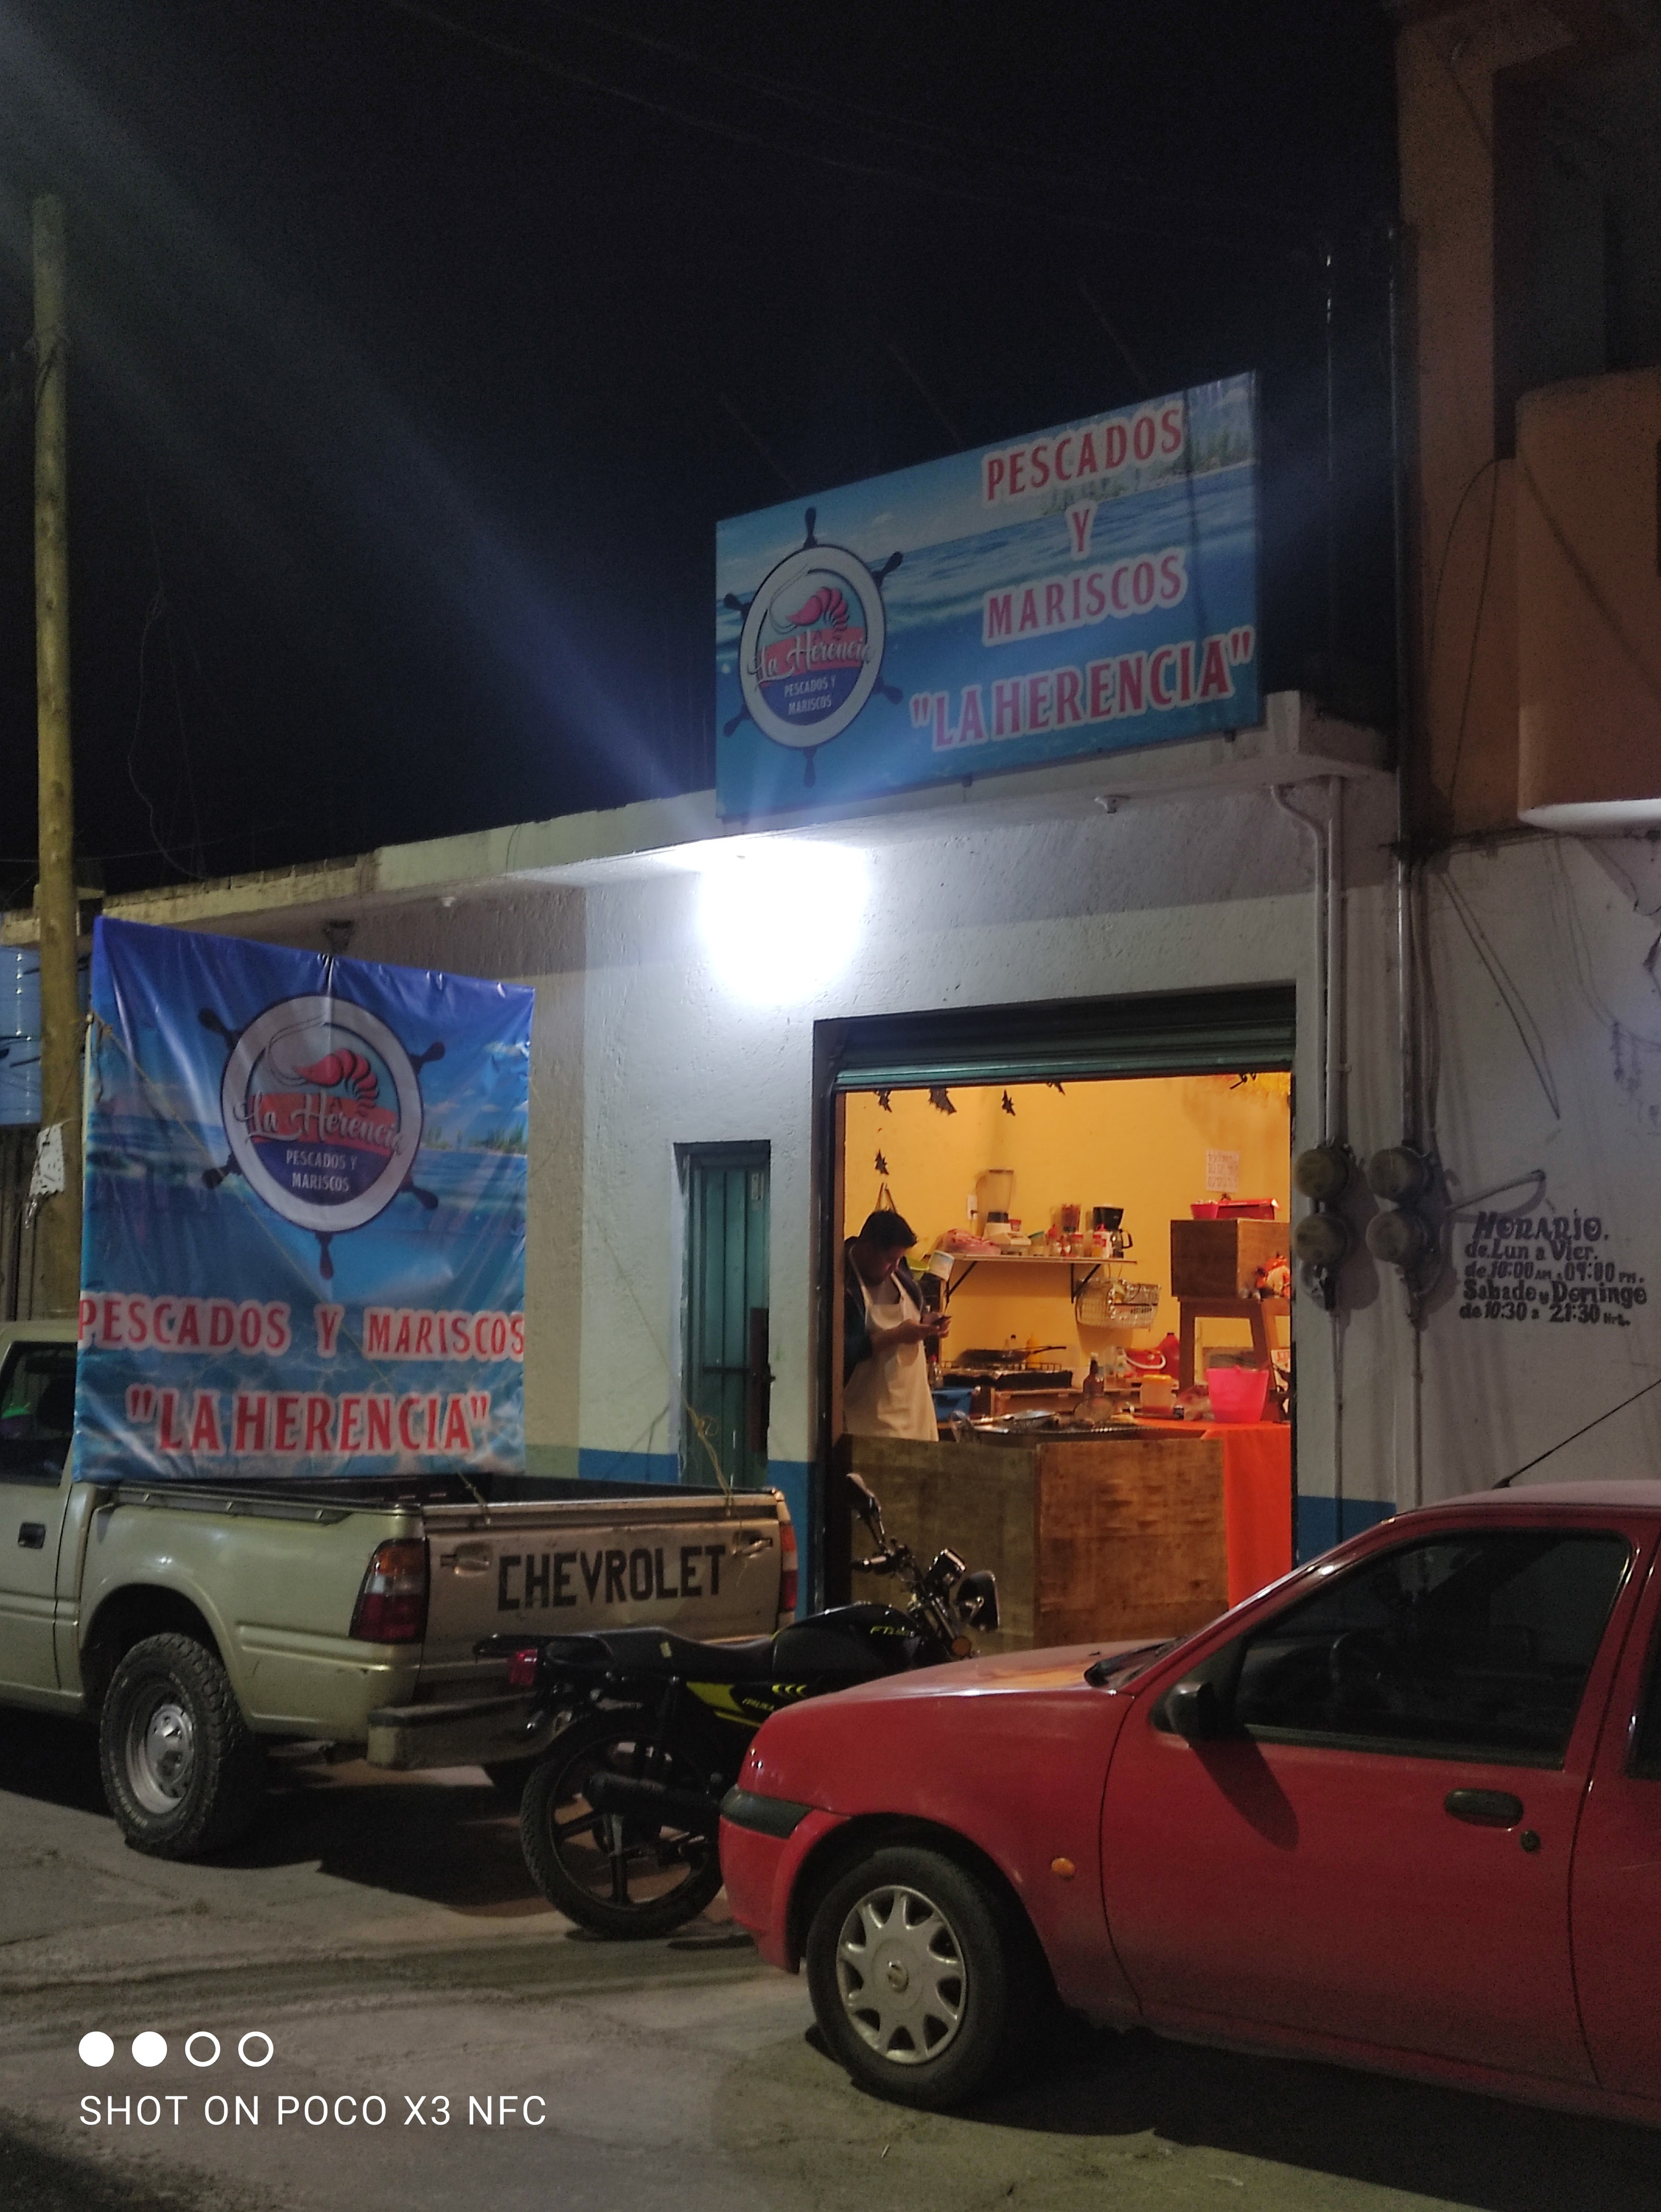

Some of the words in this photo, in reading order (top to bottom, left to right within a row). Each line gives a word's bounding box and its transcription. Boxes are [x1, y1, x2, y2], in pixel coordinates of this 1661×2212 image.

[986, 408, 1183, 500] PESCADOS
[1071, 507, 1092, 552] Y
[988, 555, 1182, 639] MARISCOS
[747, 646, 785, 685] La
[784, 676, 828, 697] PESCADOS
[830, 675, 836, 688] Y
[788, 695, 831, 715] MARISCOS
[233, 1091, 286, 1141] La
[287, 1150, 346, 1170] PESCADOS
[350, 1156, 357, 1170] Y
[292, 1172, 349, 1192] MARISCOS
[78, 1299, 285, 1349] PESCADOS
[320, 1311, 340, 1351] Y
[367, 1313, 524, 1354] MARISCOS
[1484, 1301, 1527, 1321] 10:30
[1549, 1303, 1600, 1323] 21:30
[498, 1545, 725, 1611] CHEVROLET
